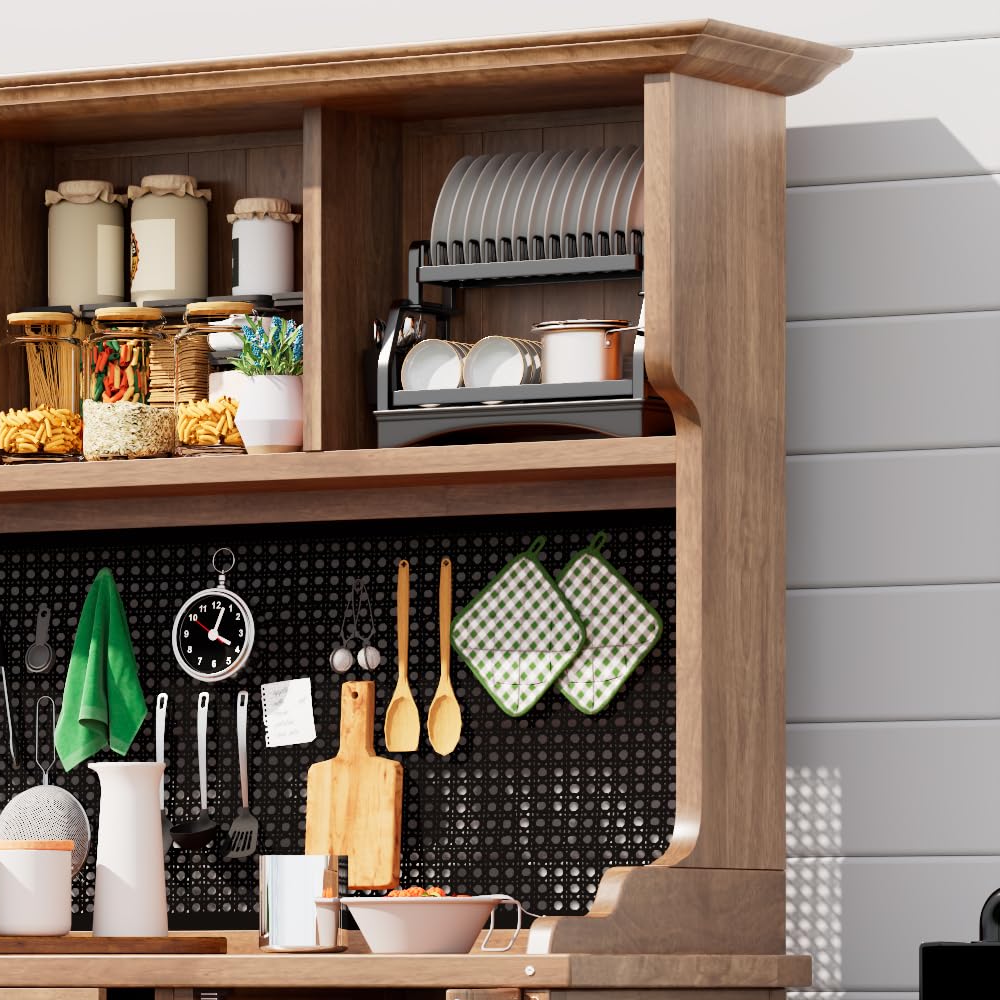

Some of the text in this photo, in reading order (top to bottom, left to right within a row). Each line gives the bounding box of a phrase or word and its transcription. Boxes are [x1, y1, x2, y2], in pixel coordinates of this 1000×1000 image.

[211, 601, 221, 609] 12
[229, 604, 233, 612] 1
[184, 630, 189, 638] 9
[238, 629, 243, 637] 3
[235, 645, 240, 653] 4
[198, 657, 202, 665] 7
[211, 660, 216, 668] 6
[226, 657, 231, 665] 5
